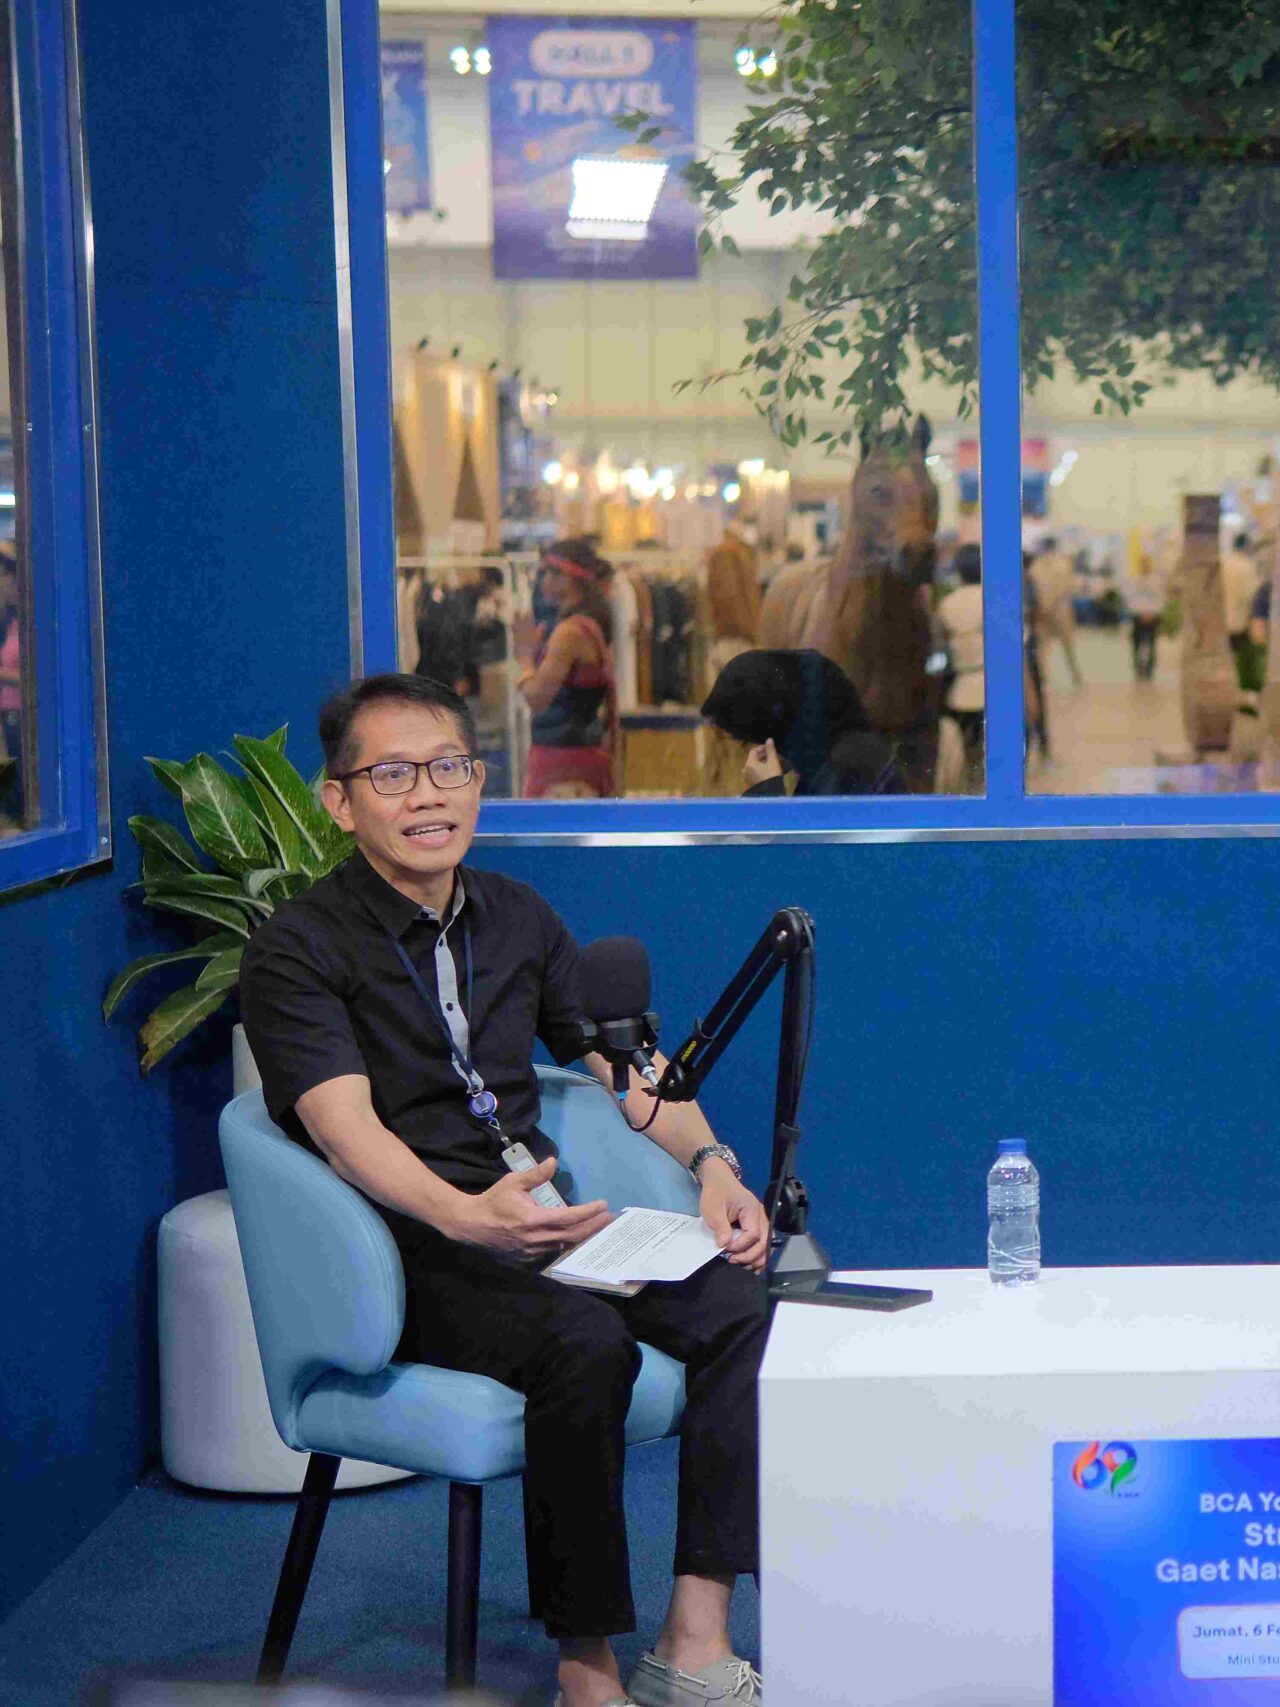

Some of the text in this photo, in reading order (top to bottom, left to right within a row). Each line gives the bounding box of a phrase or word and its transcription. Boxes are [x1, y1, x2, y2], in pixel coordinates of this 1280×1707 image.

[511, 80, 674, 114] TRAVEL
[1200, 1492, 1253, 1513] BCA
[1156, 1558, 1231, 1582] Gaet
[1253, 1624, 1262, 1636] 6
[1228, 1654, 1255, 1665] Mini
